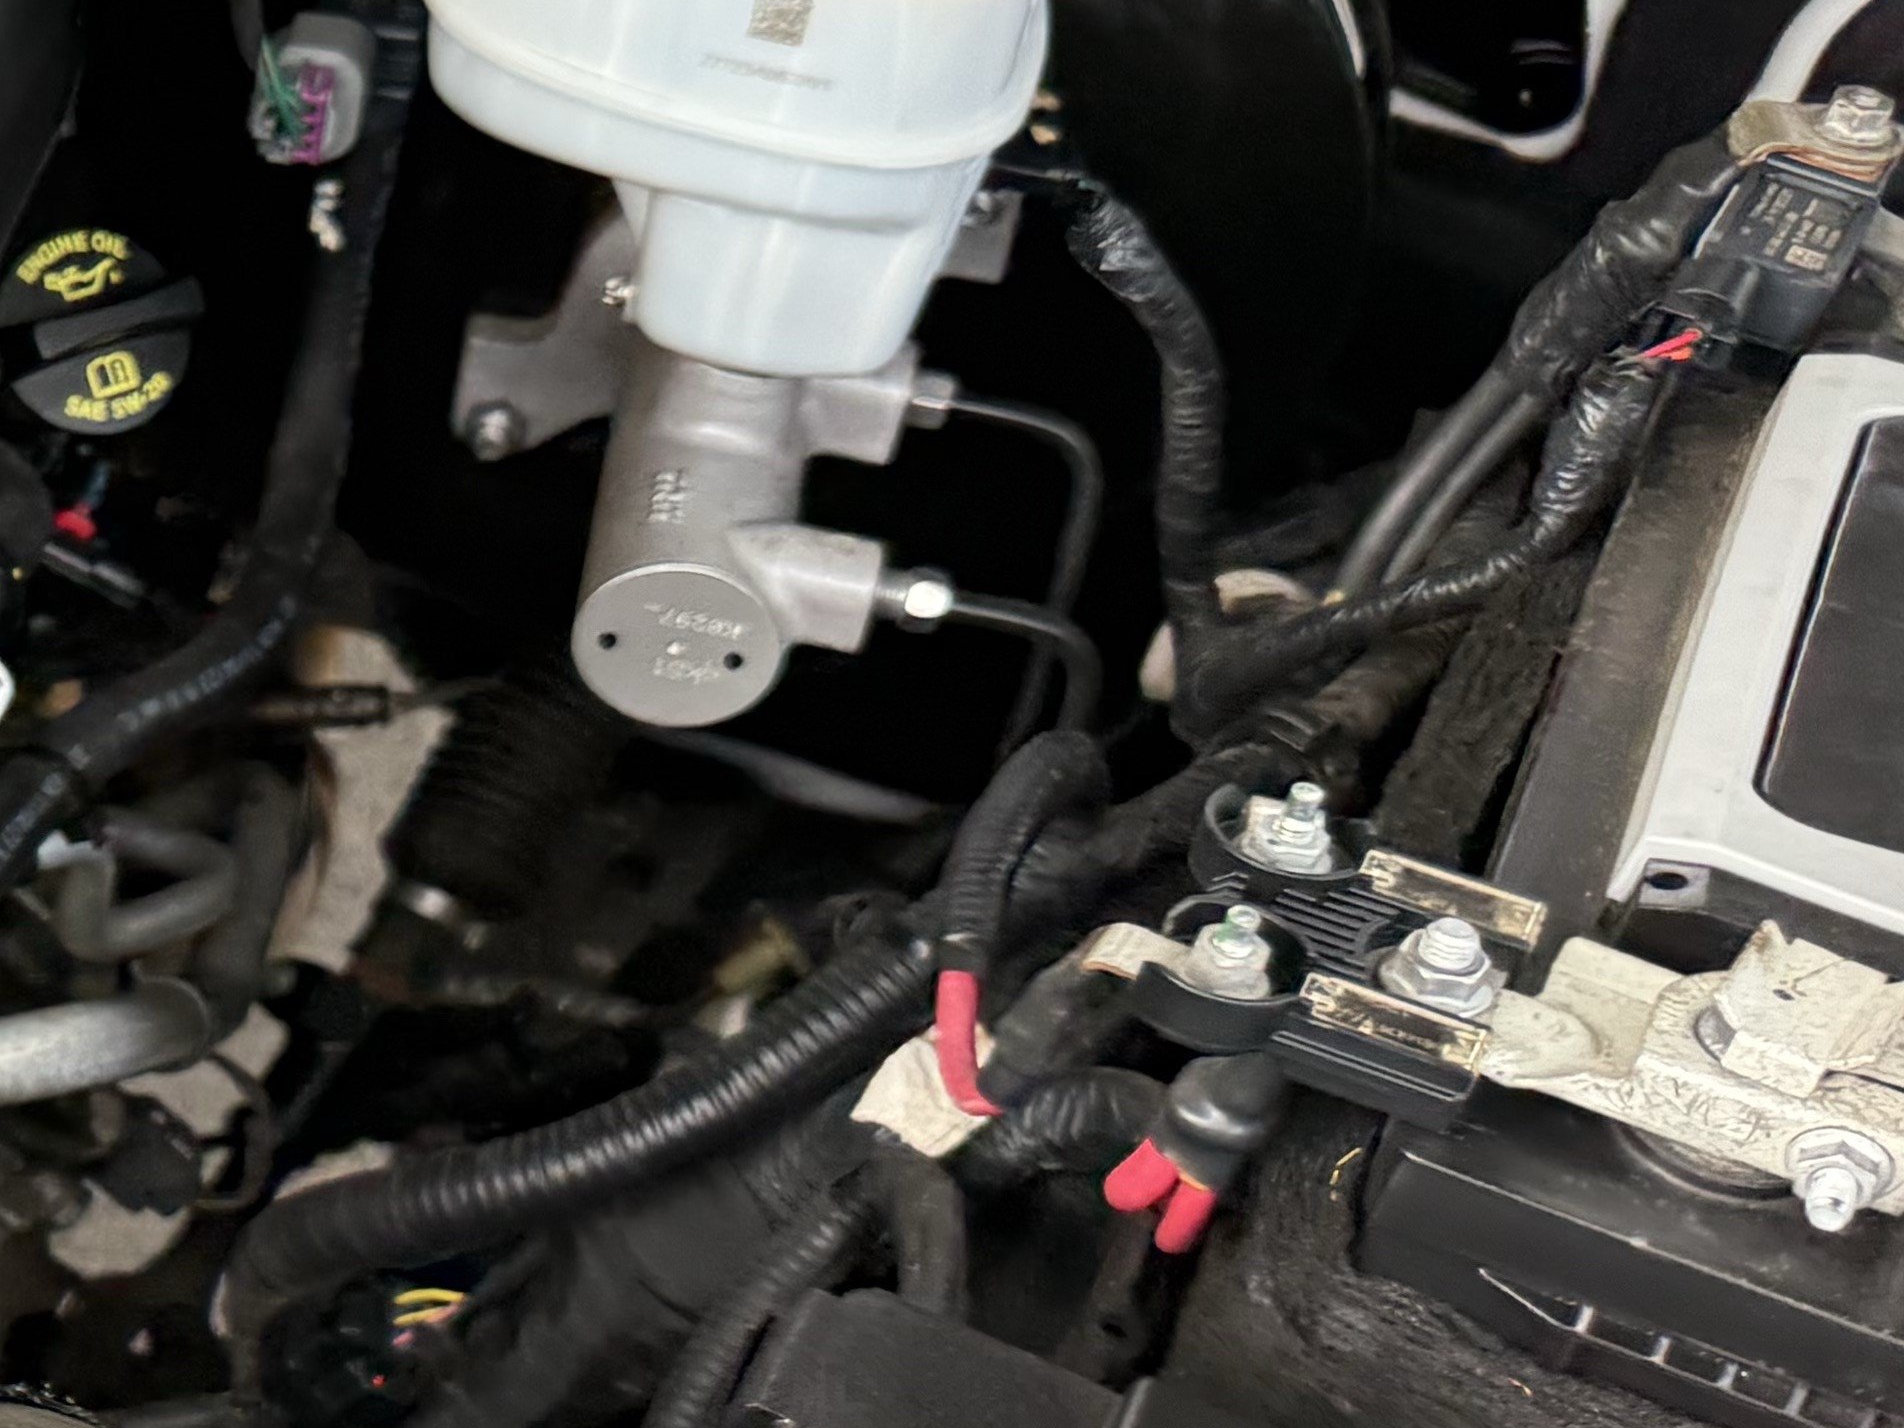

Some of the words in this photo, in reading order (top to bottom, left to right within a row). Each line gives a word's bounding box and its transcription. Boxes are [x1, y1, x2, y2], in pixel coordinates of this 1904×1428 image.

[16, 230, 90, 284] ENGINE
[91, 229, 132, 260] OIL
[64, 394, 109, 422] SAE
